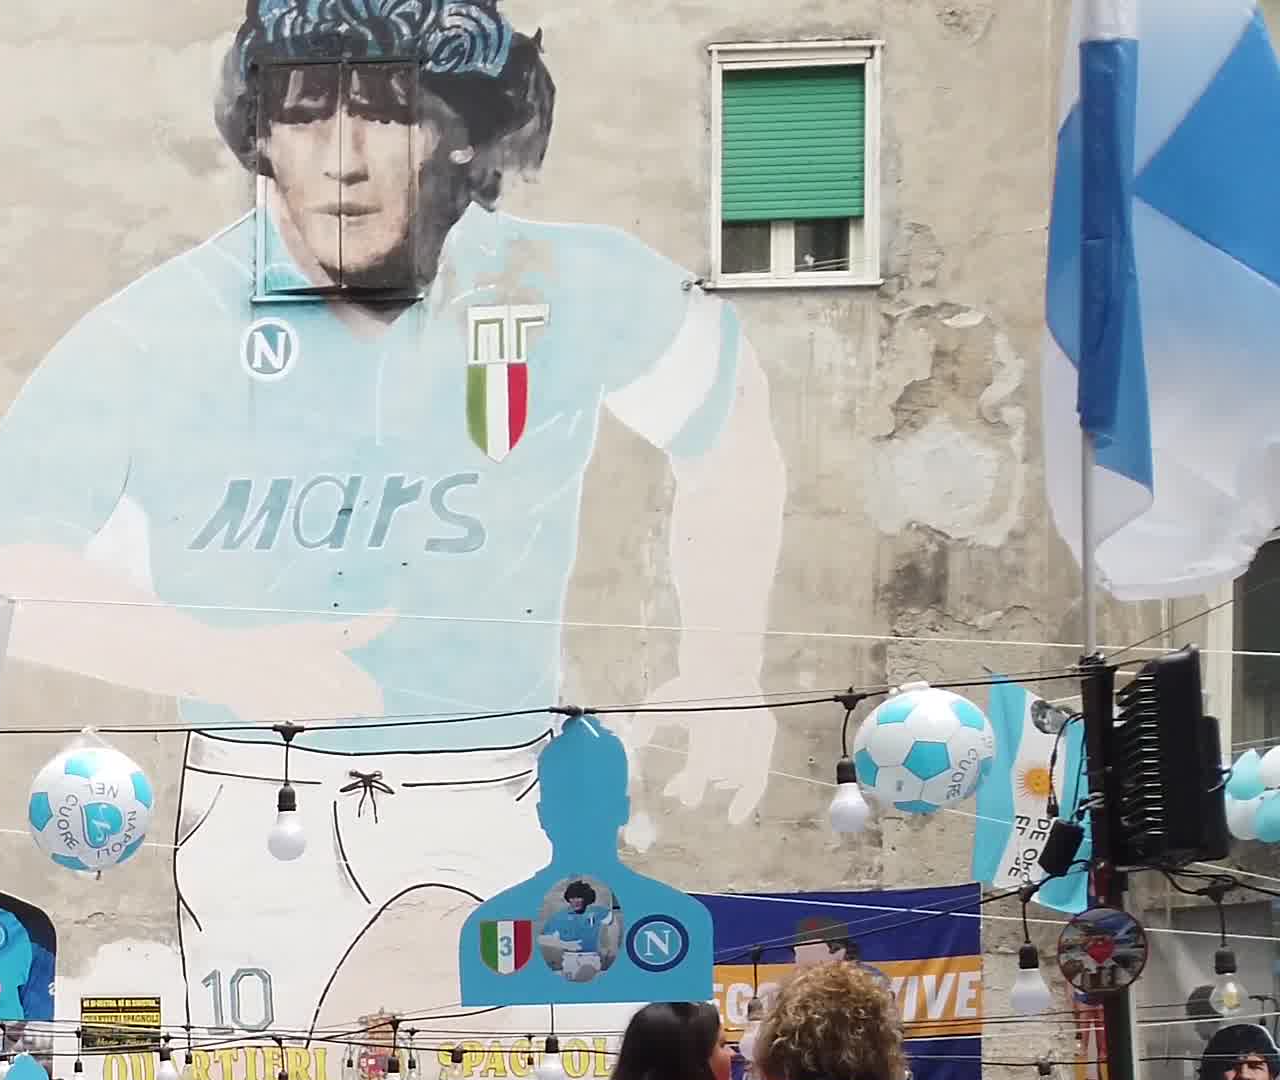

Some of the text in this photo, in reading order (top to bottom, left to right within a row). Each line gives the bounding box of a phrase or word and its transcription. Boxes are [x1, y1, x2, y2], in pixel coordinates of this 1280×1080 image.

[251, 330, 289, 370] N
[56, 794, 80, 851] CUORE
[644, 930, 670, 957] N
[201, 967, 275, 1036] 10
